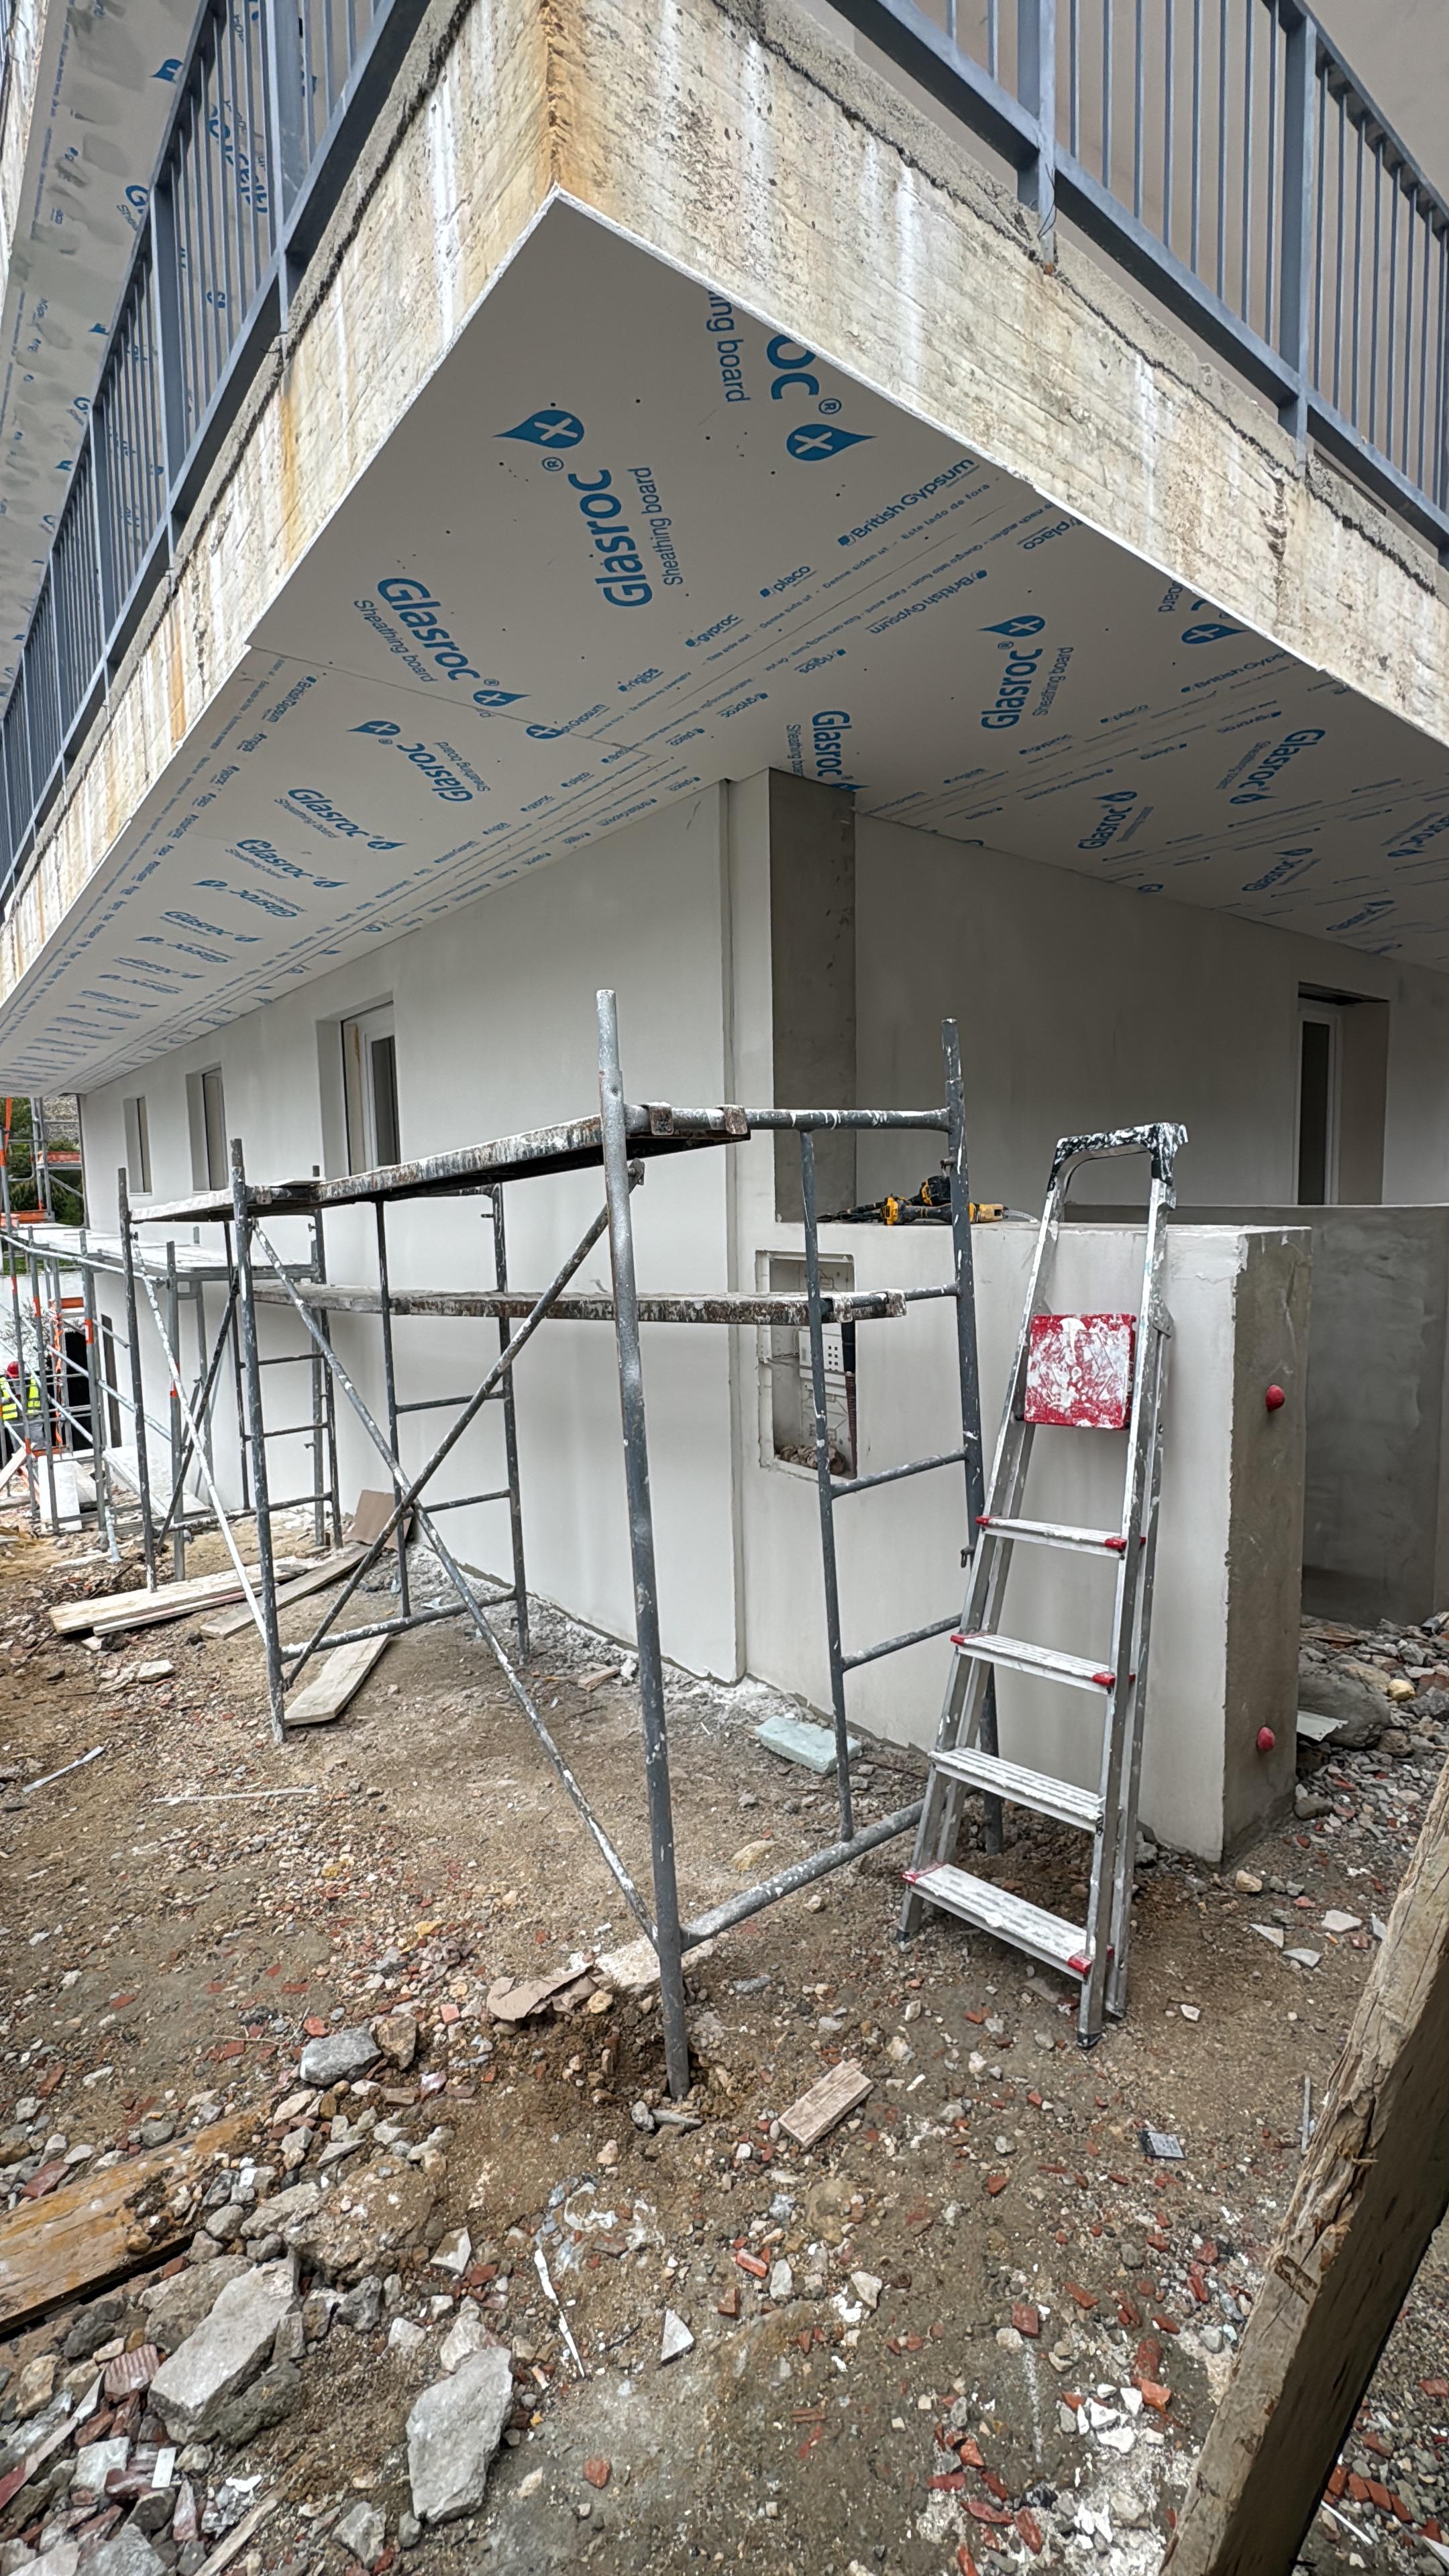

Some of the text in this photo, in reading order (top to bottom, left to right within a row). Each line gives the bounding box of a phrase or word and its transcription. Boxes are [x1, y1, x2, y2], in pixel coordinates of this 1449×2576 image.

[717, 338, 751, 403] board
[629, 468, 683, 586] Sheathing board
[851, 458, 975, 540] BritishGypsum
[923, 510, 948, 526] lado
[568, 469, 652, 607] Glasroc
[1023, 521, 1072, 550] placo
[773, 566, 810, 592] placo
[869, 576, 974, 633] BritishGypsum
[354, 598, 437, 682] Sheathing board
[378, 578, 480, 681] Glasroc
[698, 614, 739, 642] gyproc
[981, 649, 1042, 729] Glasroc
[1033, 672, 1068, 716] Sheathing
[1051, 647, 1073, 676] board
[397, 743, 473, 802] Glasroc
[435, 741, 461, 763] board
[812, 710, 852, 777] Glasroc
[1238, 729, 1326, 789] Glasroc
[288, 788, 370, 837] Glasroc
[1078, 806, 1132, 849] Glasroc
[236, 839, 313, 877] Glasroc
[229, 890, 297, 917] Glasroc
